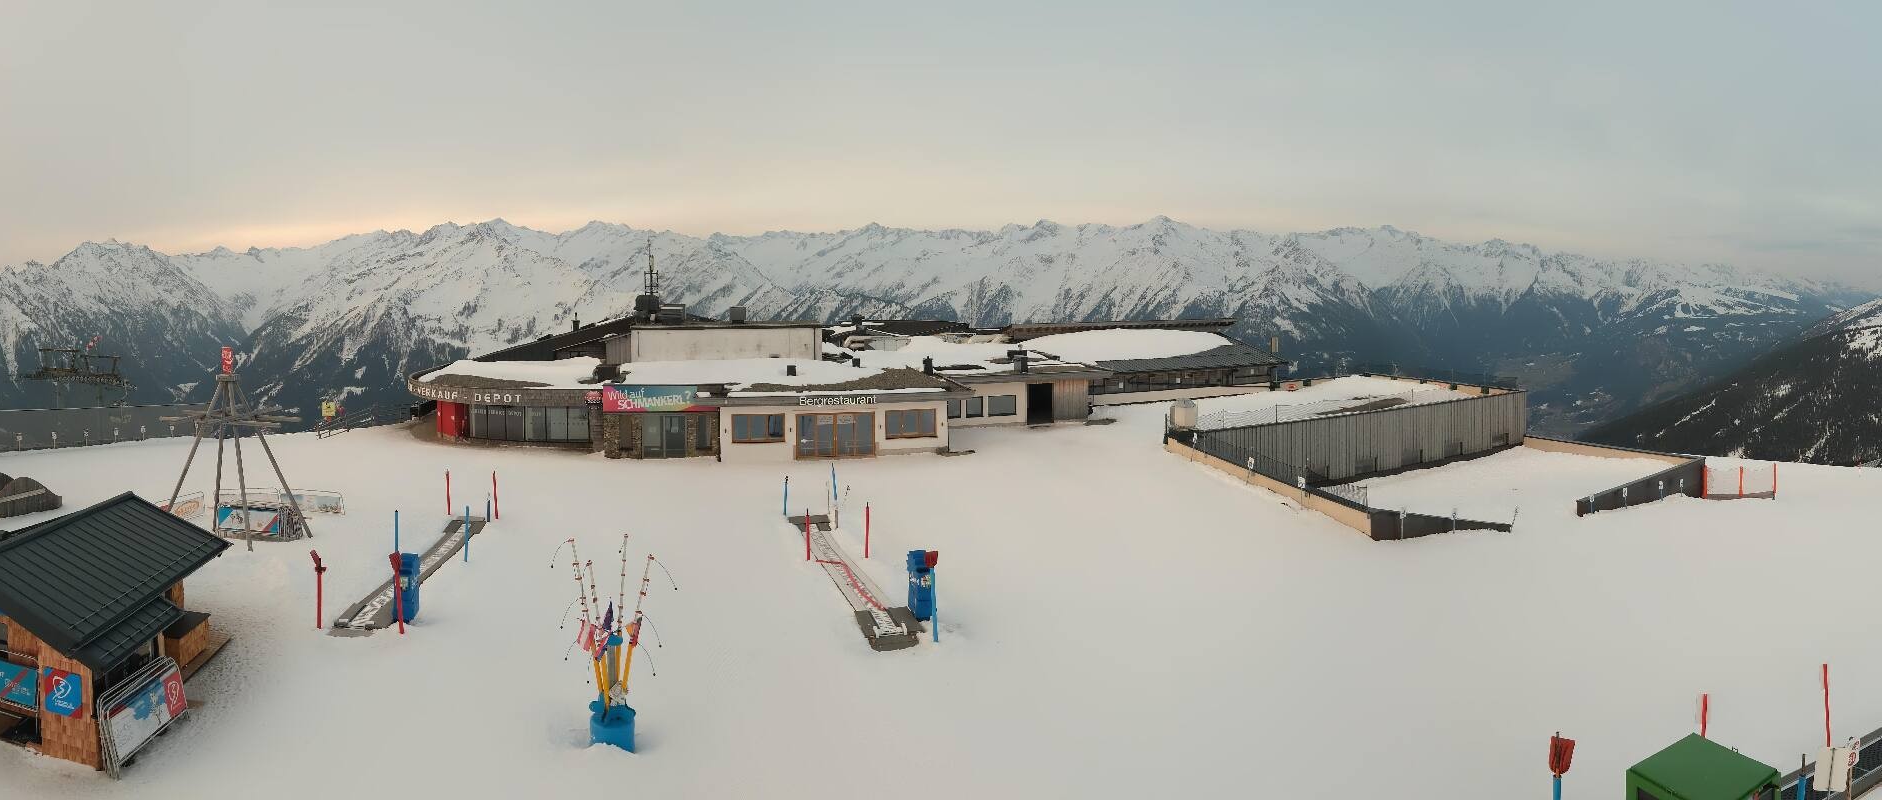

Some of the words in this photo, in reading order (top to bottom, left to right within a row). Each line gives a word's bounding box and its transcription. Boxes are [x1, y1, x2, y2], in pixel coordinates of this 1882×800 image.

[418, 387, 457, 400] VERKAUF
[475, 394, 522, 403] DEPOT
[608, 390, 628, 400] Wild
[629, 387, 645, 399] auf
[799, 395, 876, 407] Bergrestaurant
